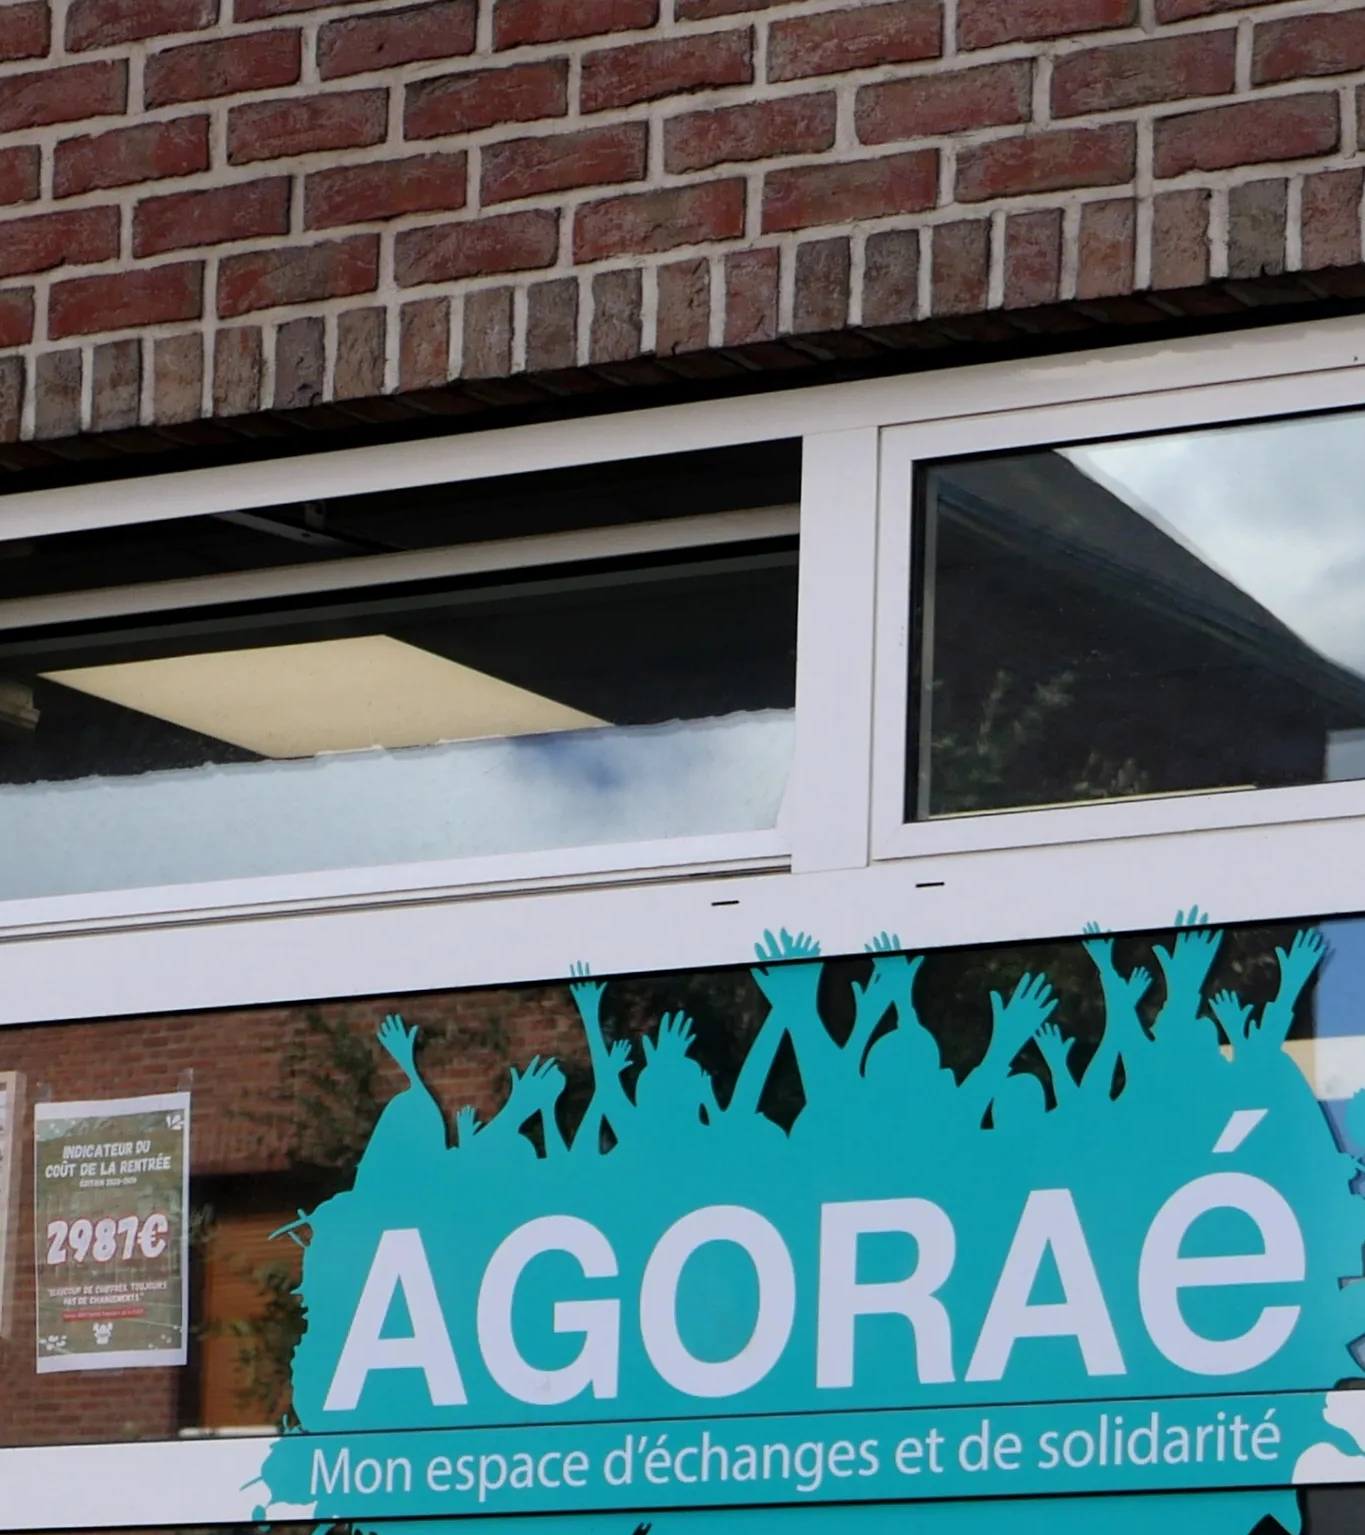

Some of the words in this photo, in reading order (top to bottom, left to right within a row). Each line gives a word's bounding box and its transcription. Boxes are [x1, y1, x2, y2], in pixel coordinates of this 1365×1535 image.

[44, 1160, 76, 1179] COÛT
[79, 1161, 98, 1177] DE
[100, 1161, 117, 1175] LA
[119, 1152, 172, 1174] RENTRÉE
[62, 1142, 134, 1160] INDICATEUR
[135, 1139, 152, 1154] DU
[46, 1213, 170, 1265] 2987€
[323, 1108, 1307, 1413] AGORAé
[309, 1445, 413, 1497] Mon
[426, 1443, 591, 1502] espace
[602, 1427, 880, 1492] d'échanges
[894, 1433, 944, 1474] et
[958, 1422, 1024, 1473] de
[1035, 1408, 1281, 1469] solidarité
